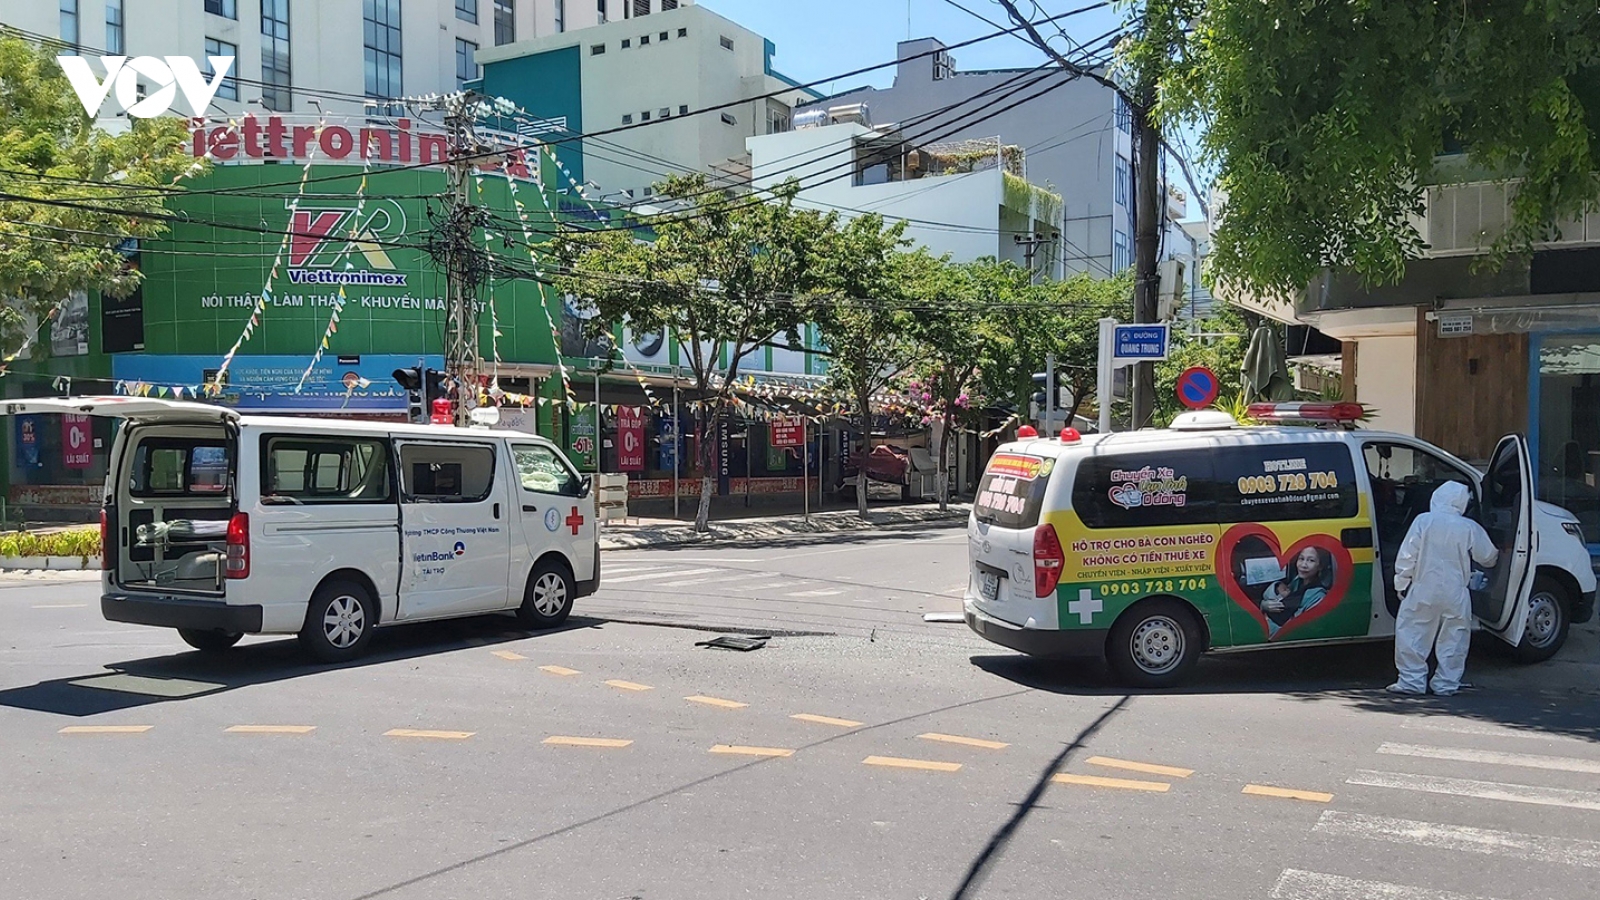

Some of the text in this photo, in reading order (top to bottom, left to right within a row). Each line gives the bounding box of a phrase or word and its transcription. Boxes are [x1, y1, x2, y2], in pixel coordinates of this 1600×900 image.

[288, 269, 406, 286] Viettronimex
[226, 292, 262, 309] THẬT
[274, 292, 303, 306] LÀM
[308, 292, 343, 309] THẬ
[361, 292, 420, 309] KHUYẾN
[425, 297, 446, 310] MÃ
[1121, 343, 1159, 354] QUANG TRUNG
[1157, 467, 1174, 479] Xe
[1263, 458, 1307, 472] HOTLINE
[1238, 471, 1338, 494] 0903 728 704
[1090, 540, 1112, 552] TRỢ
[1114, 538, 1136, 549] CHO
[1138, 536, 1152, 547] BÀ
[1154, 537, 1177, 547] CON
[1178, 533, 1214, 545] NGHÈO
[413, 551, 455, 562] ietinBank
[1082, 550, 1206, 566] KHÔNG CÓ TIỀN THUÊ XE
[1132, 567, 1152, 576] NHẬP
[1153, 565, 1170, 575] VIỆN
[1101, 578, 1207, 596] 0903 728 704
